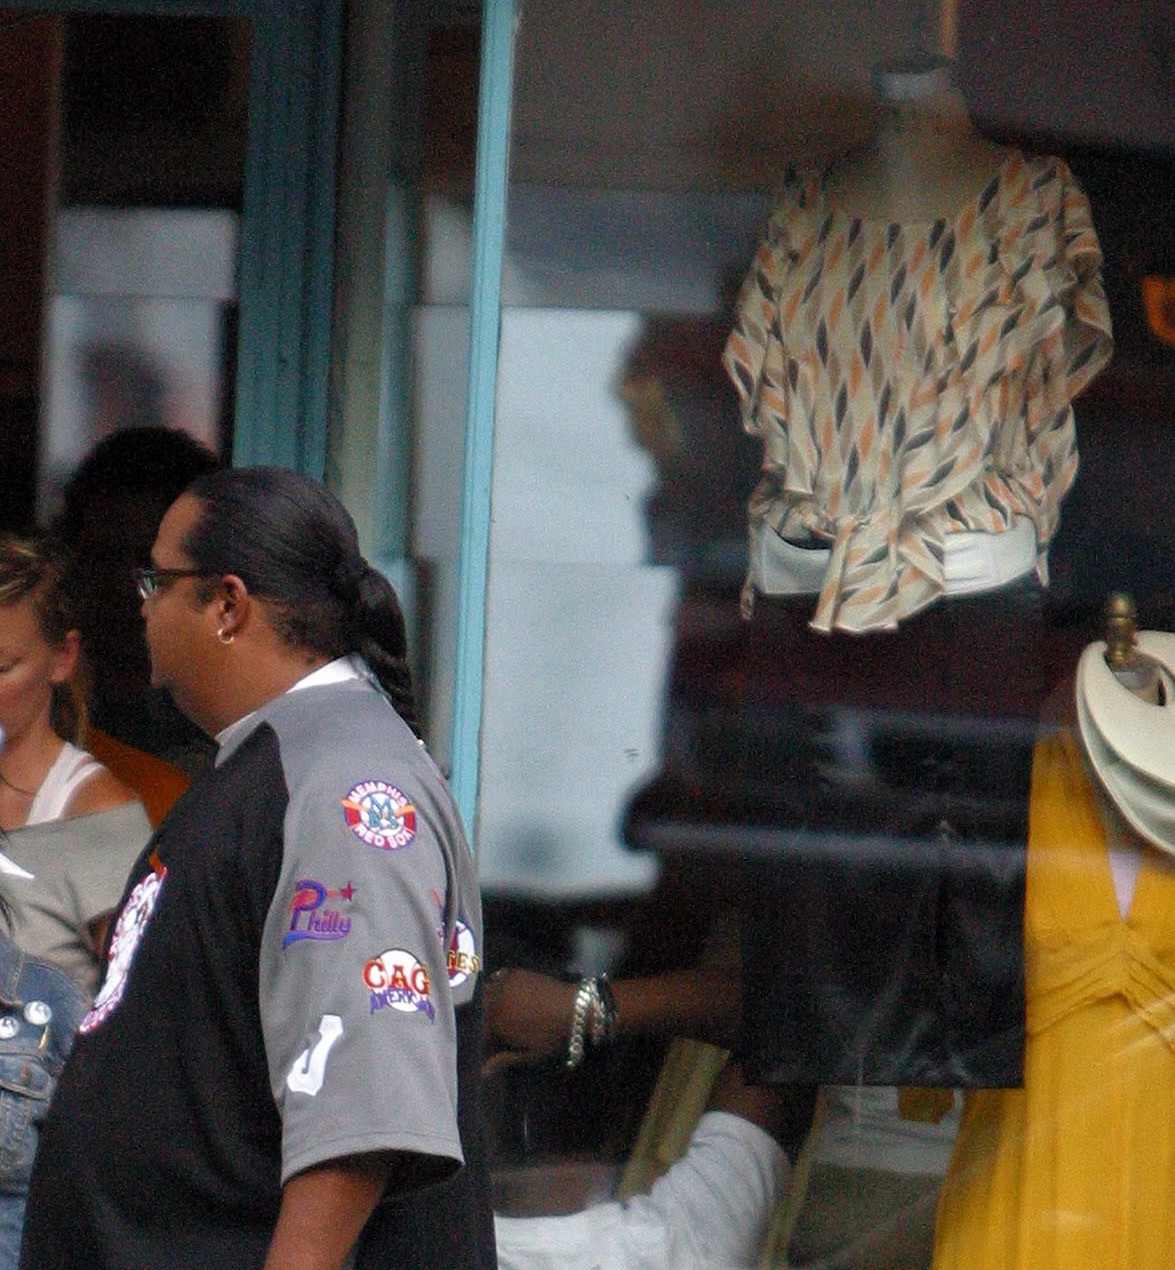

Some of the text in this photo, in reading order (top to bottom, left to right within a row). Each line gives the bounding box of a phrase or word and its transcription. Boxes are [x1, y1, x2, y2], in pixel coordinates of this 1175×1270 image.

[347, 781, 408, 807] MEMPHIS
[353, 823, 385, 847] RED
[283, 880, 352, 949] Philly
